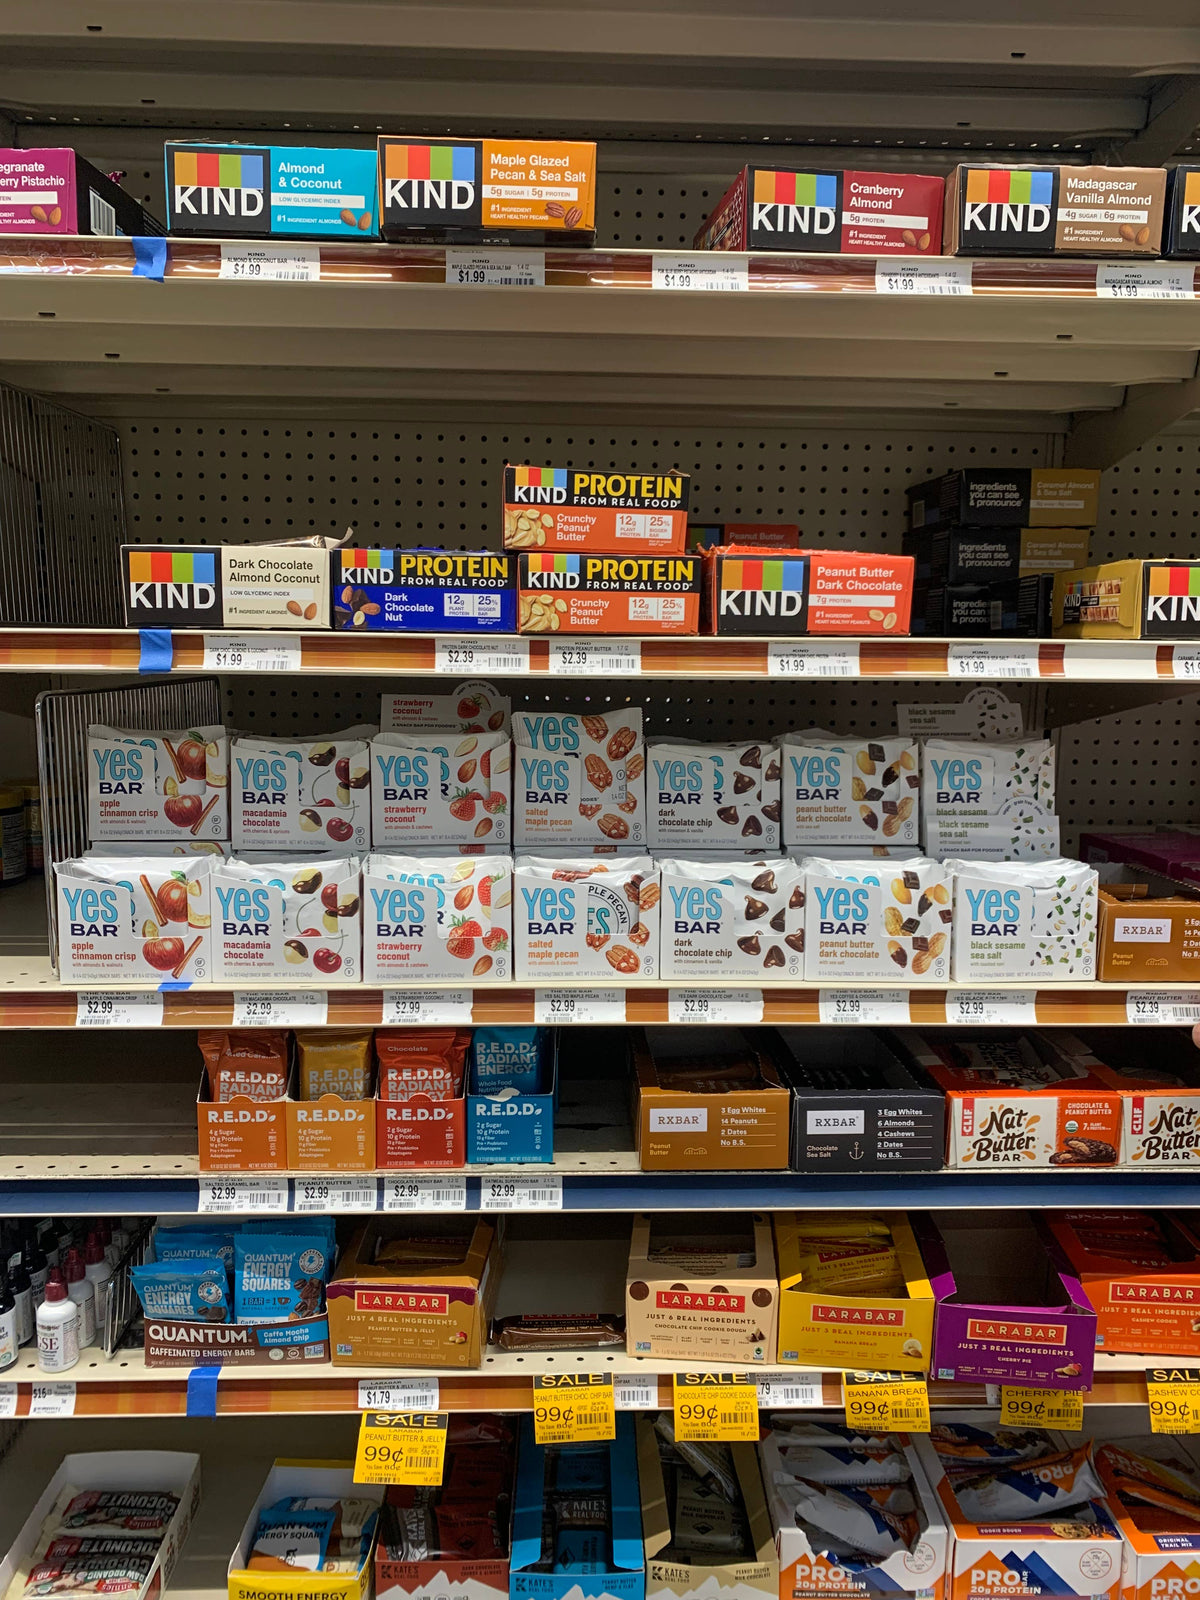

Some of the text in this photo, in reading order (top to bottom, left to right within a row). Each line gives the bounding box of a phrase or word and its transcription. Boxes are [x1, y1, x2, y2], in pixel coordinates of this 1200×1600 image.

[491, 154, 569, 168] Maple Glazed
[278, 163, 324, 174] Almond
[491, 169, 586, 182] Pecan & Sea Salt
[278, 178, 342, 189] & Coconut
[1068, 178, 1137, 191] Madagascar
[385, 180, 475, 209] KIND
[491, 187, 502, 197] 5g
[532, 188, 542, 198] 5g
[851, 183, 903, 198] Cranberry
[174, 186, 264, 216] KIND
[850, 197, 892, 209] Almond
[1067, 193, 1151, 205] Vanilla Almond
[753, 203, 835, 234] KIND
[964, 203, 1050, 232] KIND
[233, 263, 261, 276] $1.99
[458, 270, 485, 283] $1.99
[1112, 285, 1137, 296] $1.99
[514, 474, 682, 504] KIND PROTEIN
[970, 482, 1016, 492] ingredients
[970, 491, 1020, 500] you can see
[574, 497, 677, 507] FROM REAL FOOD
[557, 514, 596, 525] Crunchy
[557, 524, 589, 532] Peanut
[557, 532, 585, 541] Butter
[230, 560, 313, 570] Dark Chocolate
[401, 555, 508, 577] PROTEIN
[230, 573, 320, 583] Almond Coconut
[818, 567, 894, 578] Peanut Butter
[401, 577, 504, 587] FROM REAL FOOD
[817, 580, 902, 591] Dark Chocolate
[131, 583, 215, 609] KIND
[385, 603, 434, 612] Chocolate
[216, 653, 242, 666] $1.99
[448, 651, 473, 664] $2.39
[562, 652, 587, 665] $2.39
[960, 661, 984, 673] $1.99
[100, 783, 142, 794] BAR
[100, 799, 120, 808] apple
[100, 808, 158, 819] cinnamon crisp
[384, 805, 427, 816] strawberry
[796, 805, 846, 814] peanut butter
[384, 815, 416, 823] coconut
[815, 814, 852, 822] chocolate
[528, 922, 574, 935] BAR
[1123, 926, 1163, 934] RXBAR
[224, 941, 271, 950] macadamia
[528, 940, 553, 948] salted
[674, 939, 692, 947] dark
[224, 951, 264, 959] chocolate
[528, 951, 579, 959] maple pecan
[674, 949, 732, 958] chocolate chip
[988, 951, 1002, 959] salt
[87, 1001, 112, 1014] $2.99
[836, 1000, 860, 1012] $2.99
[1136, 1002, 1159, 1013] $2.39
[477, 1053, 536, 1064] RADIANT
[478, 1065, 532, 1076] ENERGY
[727, 1106, 740, 1114] Egg
[658, 1116, 699, 1124] RXBAR
[963, 1108, 973, 1132] CLIF
[212, 1187, 235, 1200] $2.99
[245, 1254, 293, 1262] QUANTUM
[243, 1263, 290, 1278] ENERGY
[242, 1278, 290, 1291] SQUARES
[676, 1315, 697, 1323] REAL
[700, 1317, 756, 1325] INGREDIENTS
[150, 1325, 248, 1343] QUANTUM
[287, 1327, 309, 1335] Mocha
[150, 1347, 200, 1357] CAFFEINATED
[203, 1348, 232, 1357] ENERGY
[367, 1391, 390, 1404] $1.79
[848, 1389, 889, 1397] BANANA
[850, 1401, 889, 1419] 99¢
[374, 1414, 438, 1427] SALE
[392, 1434, 418, 1442] BUTTER
[424, 1435, 444, 1443] JELLY
[364, 1446, 403, 1468] 99¢
[971, 1570, 1020, 1586] PRO
[796, 1581, 815, 1589] 20g
